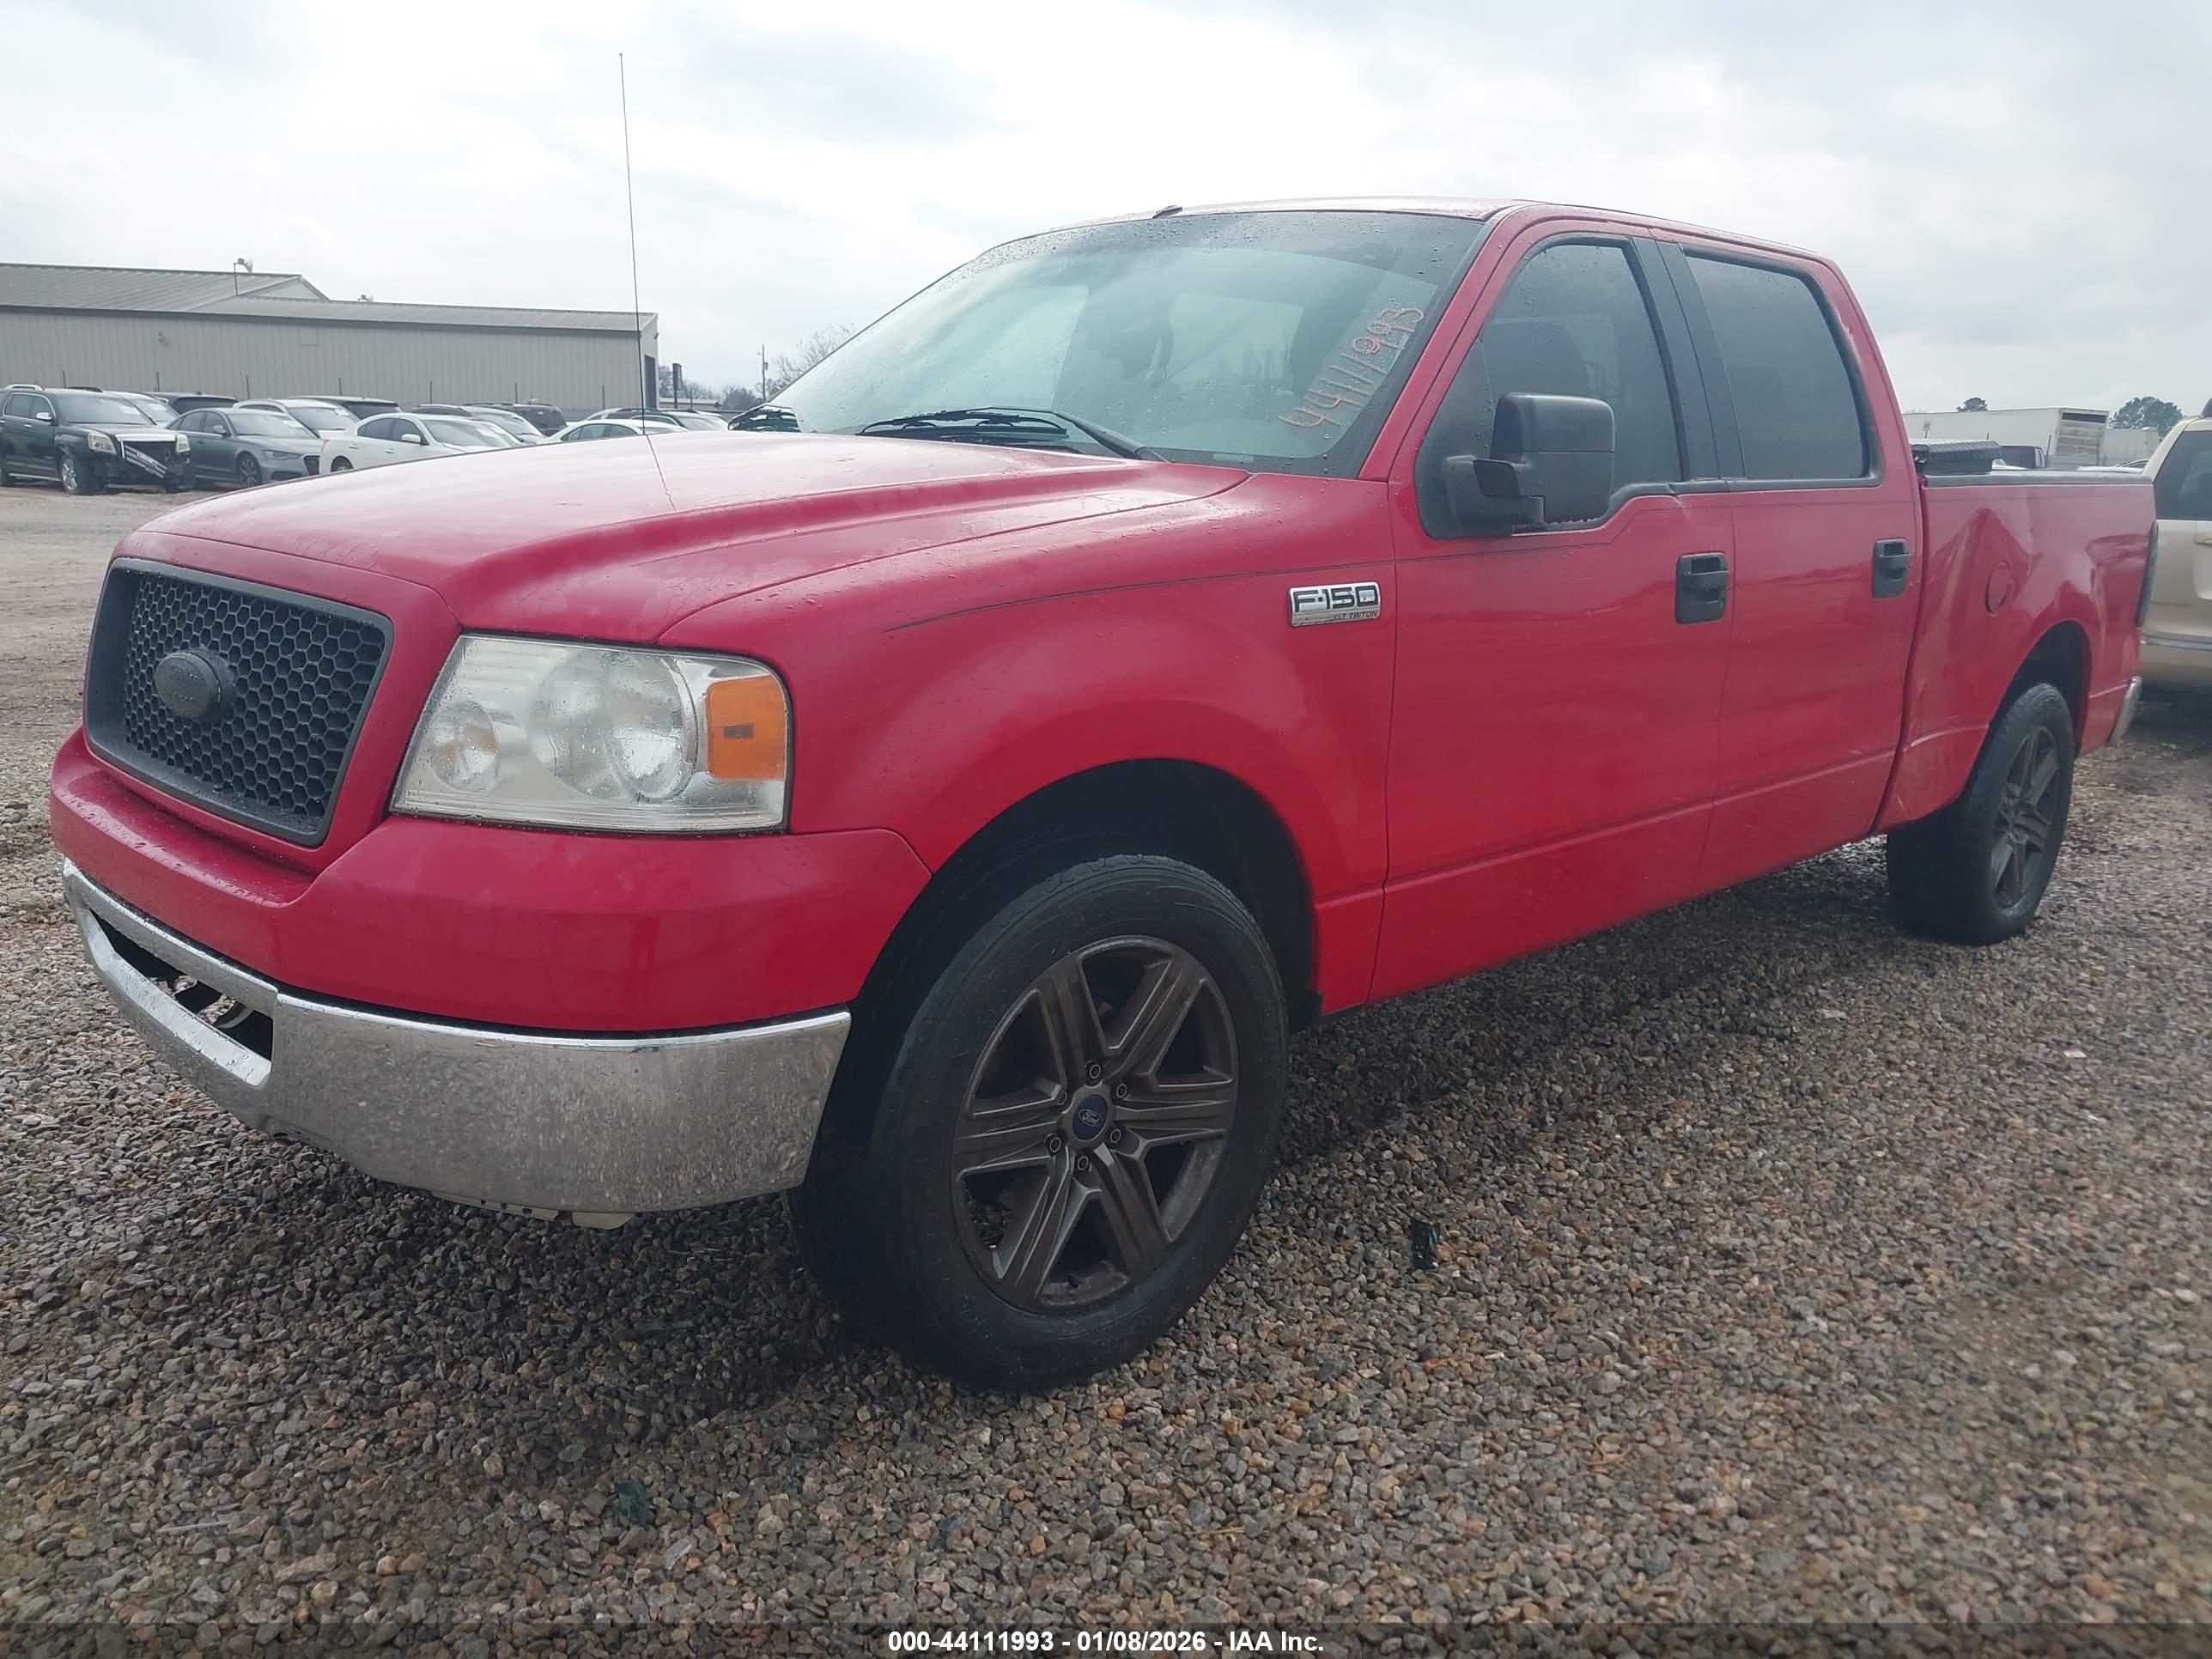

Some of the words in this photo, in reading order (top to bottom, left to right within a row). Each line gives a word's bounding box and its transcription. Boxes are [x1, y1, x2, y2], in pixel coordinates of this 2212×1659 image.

[1278, 307, 1425, 428] 44111993
[1292, 585, 1378, 613] F-150
[1349, 611, 1377, 619] TRITON
